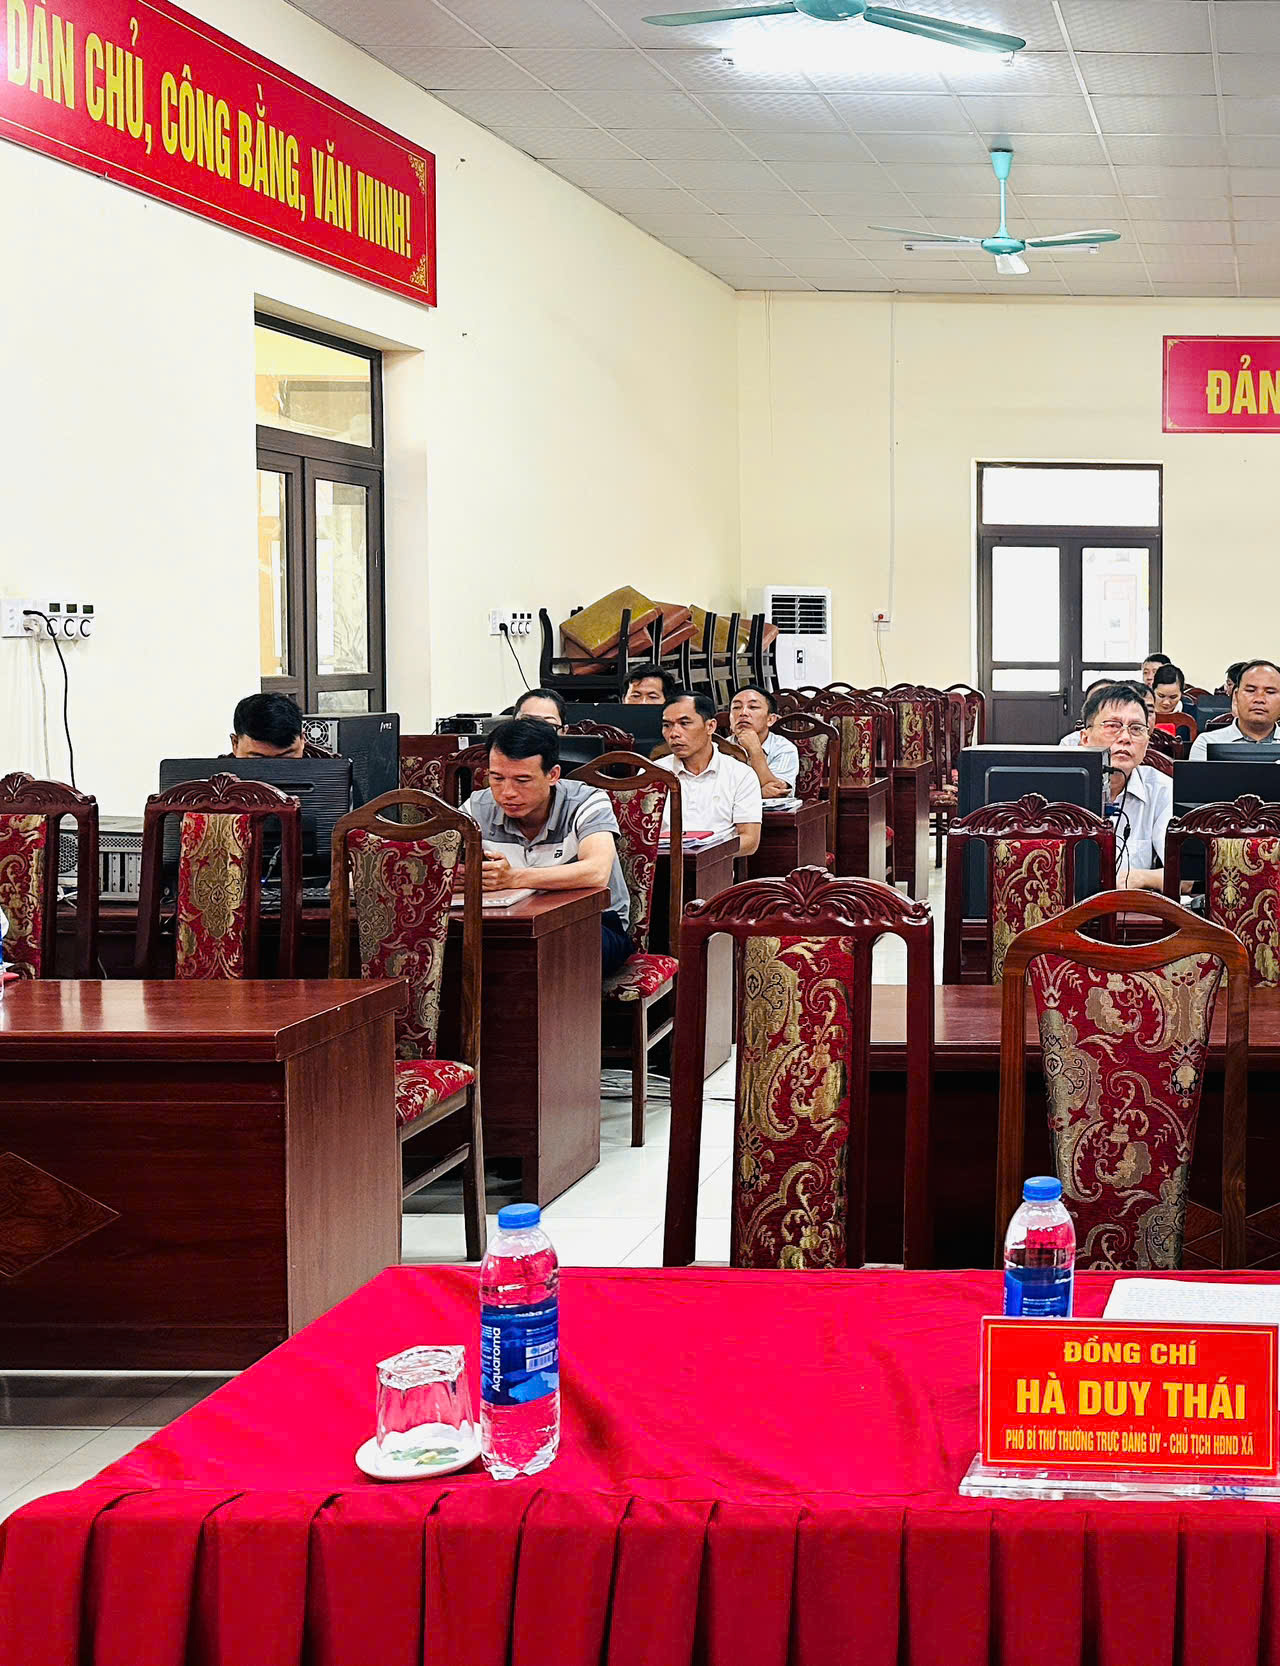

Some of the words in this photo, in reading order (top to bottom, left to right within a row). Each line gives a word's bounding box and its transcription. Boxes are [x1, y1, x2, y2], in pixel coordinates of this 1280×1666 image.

[85, 16, 153, 155] CHỦ,
[160, 64, 231, 180] CÔNG
[238, 84, 306, 222] BẰNG,
[311, 139, 353, 233] VĂN
[357, 170, 412, 259] MINH!
[491, 1327, 503, 1392] Aquaroma
[1063, 1335, 1141, 1364] ĐỒNG
[1150, 1339, 1198, 1366] CHÍ
[1016, 1371, 1066, 1415] HÀ
[1078, 1379, 1151, 1417] DUY
[1162, 1376, 1247, 1420] THÁI
[1006, 1426, 1024, 1450] PHÓ
[1026, 1425, 1037, 1450] BÍ
[1038, 1428, 1056, 1451] THƯ
[1058, 1425, 1094, 1452] THƯỜNG
[1096, 1430, 1120, 1456] TRỰC
[1121, 1425, 1147, 1453] ĐẢNG
[1149, 1425, 1161, 1454] ỦY
[1170, 1427, 1189, 1454] CHỦ
[1191, 1433, 1211, 1459] TỊCH
[1213, 1434, 1239, 1455] HĐND
[1241, 1431, 1254, 1456] XÃ
